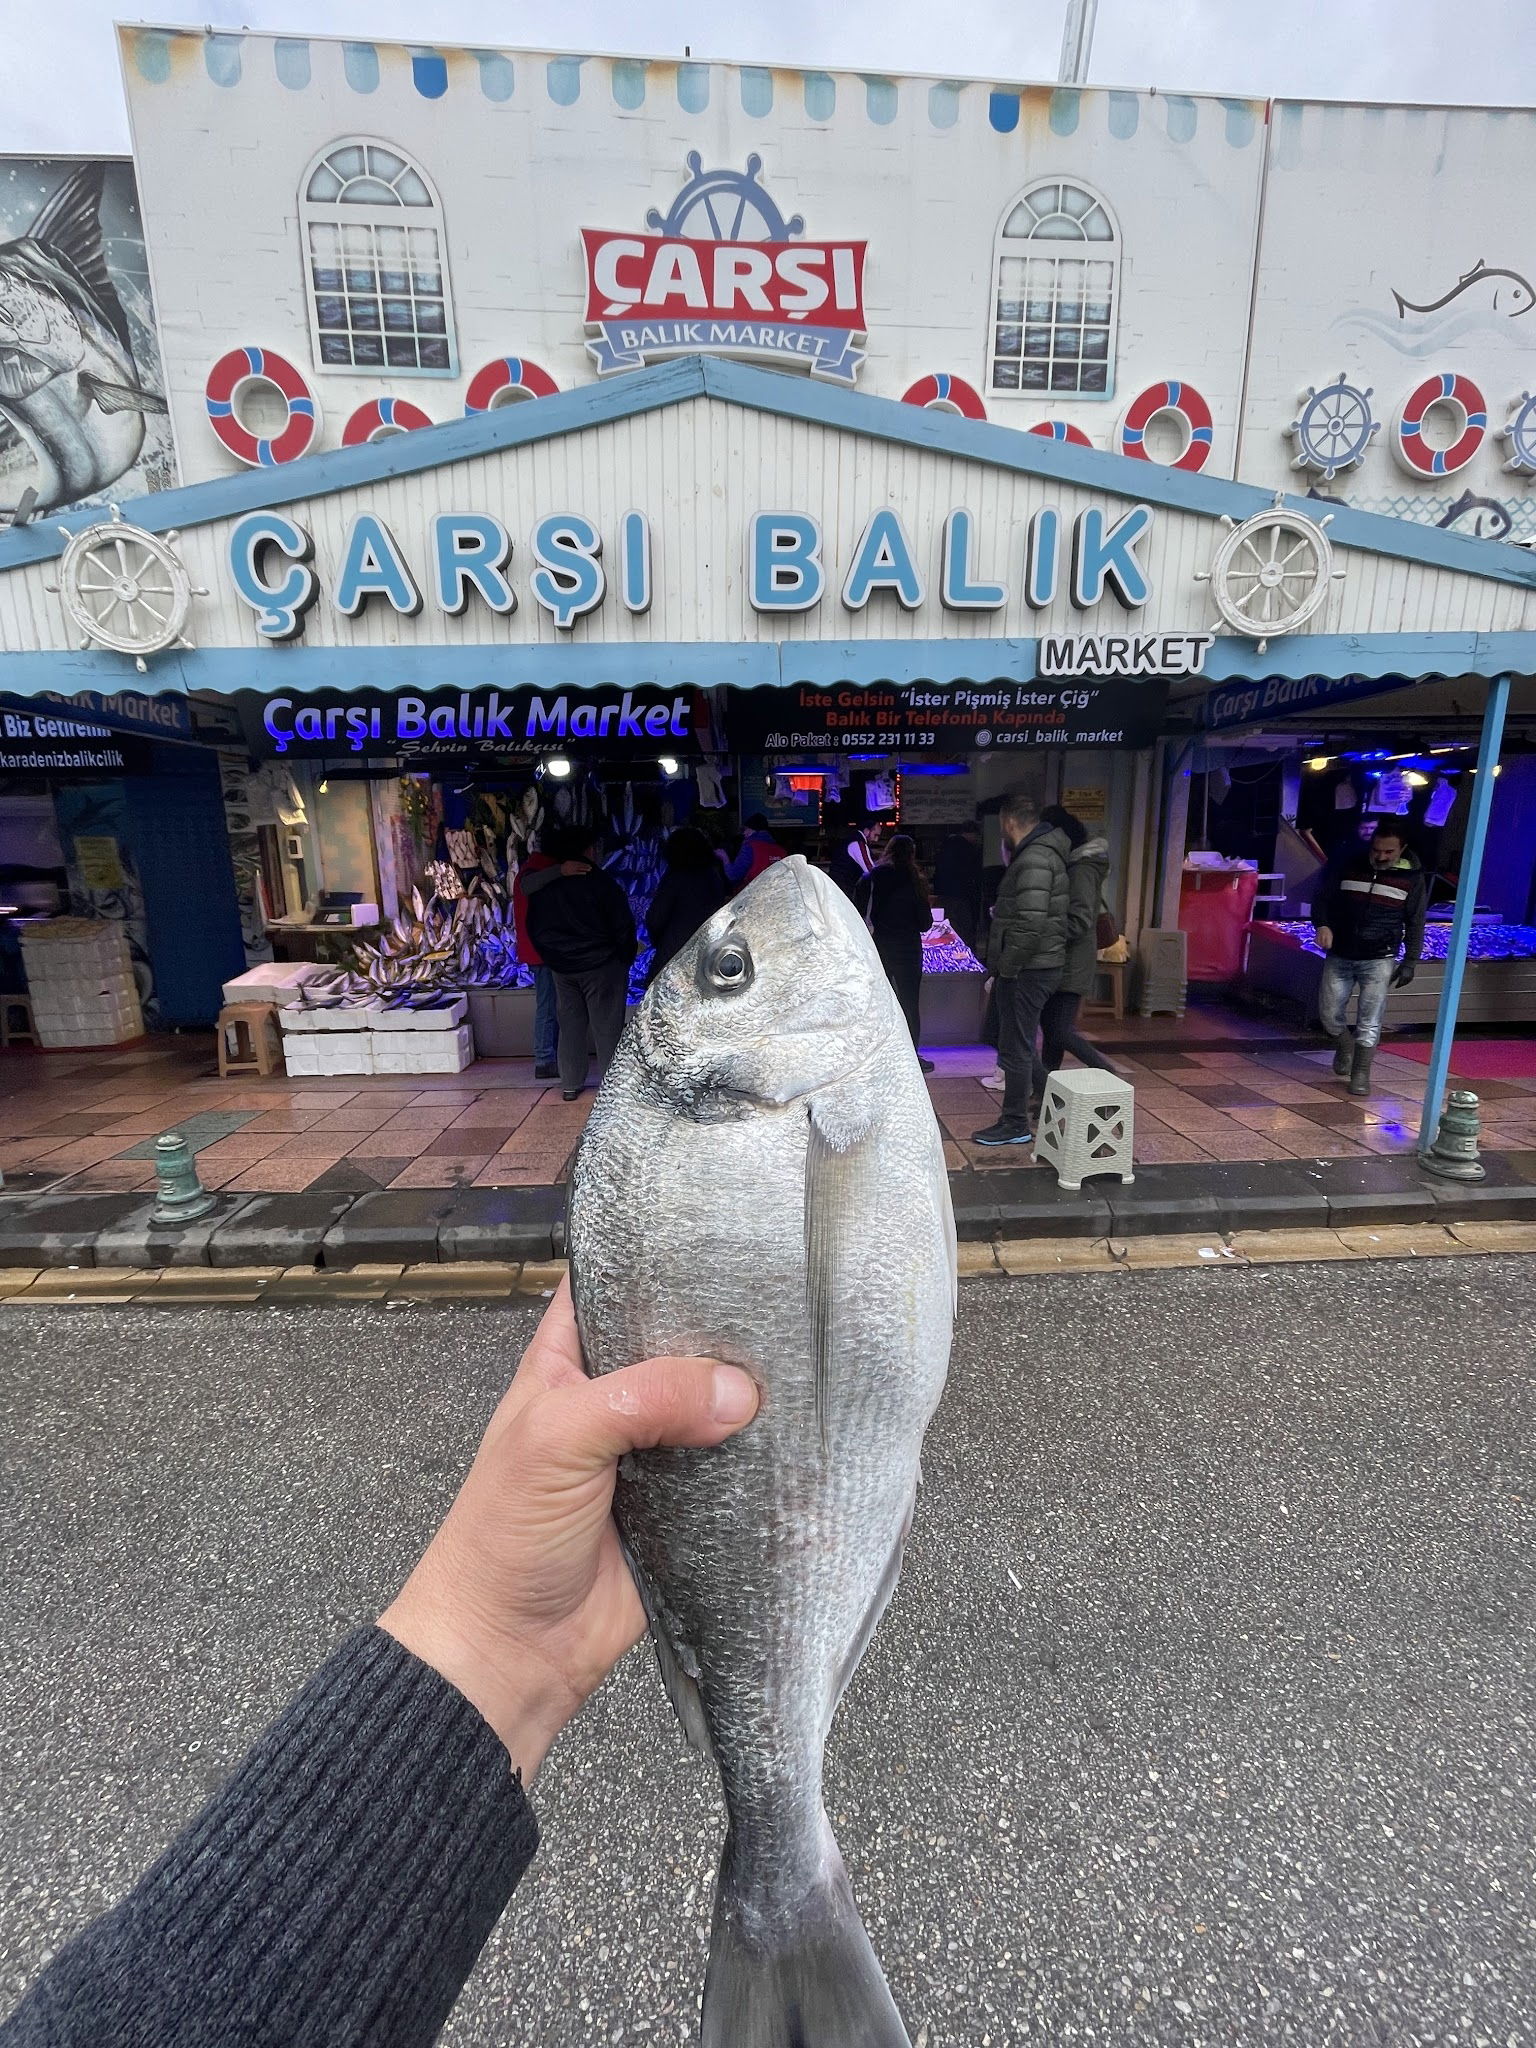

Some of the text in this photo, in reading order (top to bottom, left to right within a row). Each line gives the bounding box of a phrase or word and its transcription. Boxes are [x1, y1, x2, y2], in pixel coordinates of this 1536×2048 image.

[594, 239, 858, 320] ÇARŞI
[621, 323, 831, 356] BALIK MARKET
[227, 503, 1154, 639] ÇARŞI BALIK
[1046, 636, 1210, 671] MARKET
[800, 688, 833, 707] İste
[838, 690, 895, 707] Gelsin
[955, 690, 1011, 709] Pişmiş
[1016, 687, 1056, 706] İster
[1212, 689, 1259, 727] Çarşı
[4, 714, 32, 738] Biz
[263, 691, 690, 752] Çarşı Balık Market
[826, 709, 1066, 728] Balık Bir Telefonla Kapında
[765, 732, 789, 748] Alo
[791, 731, 831, 747] Paket
[842, 733, 875, 746] 0552
[878, 733, 901, 745] 231
[904, 733, 916, 745] 11
[919, 732, 936, 745] 33
